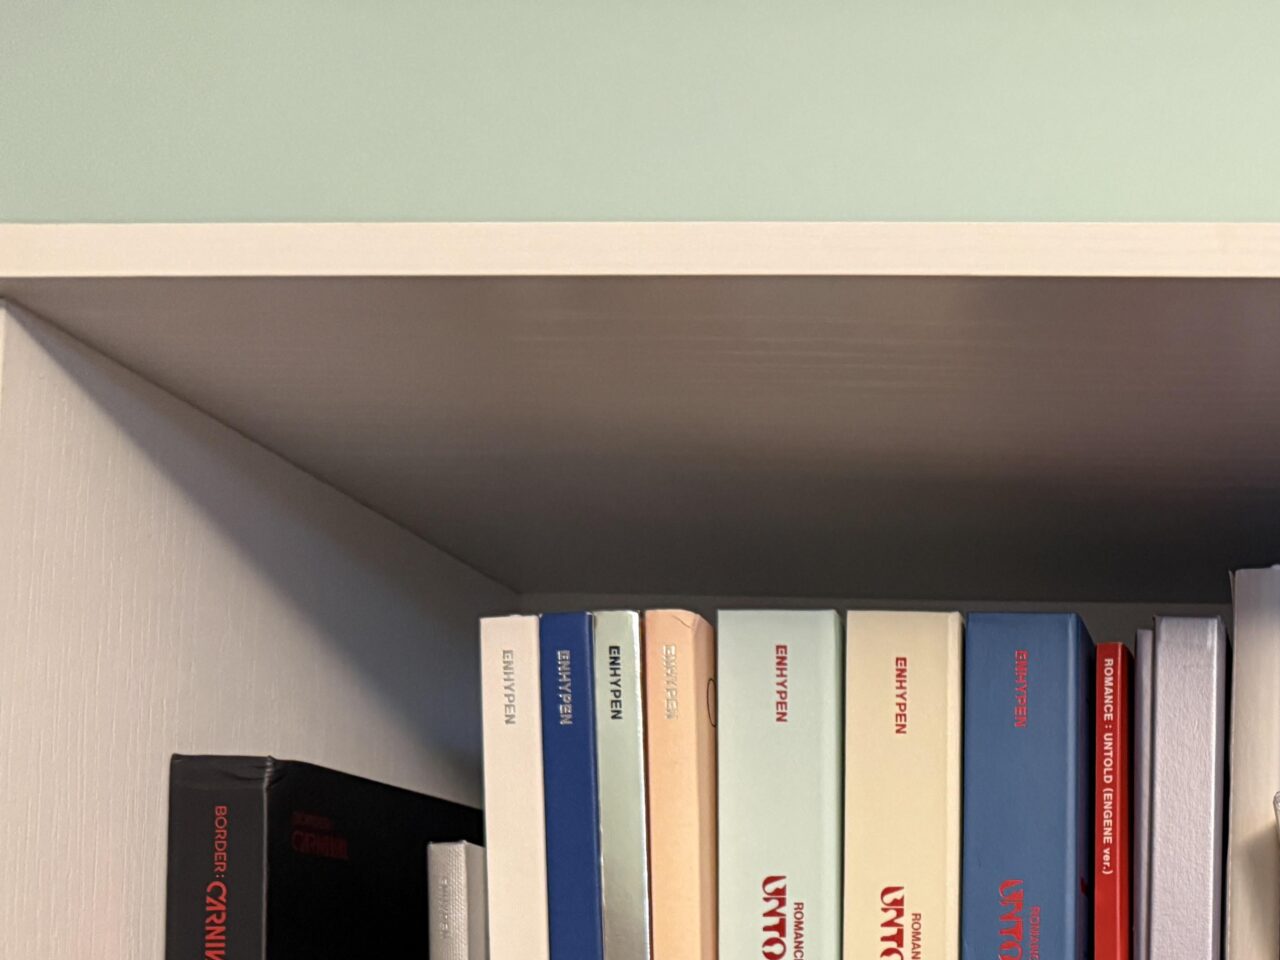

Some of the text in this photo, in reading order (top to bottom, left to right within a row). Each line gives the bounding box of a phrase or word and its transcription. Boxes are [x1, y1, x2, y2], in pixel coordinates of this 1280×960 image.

[502, 649, 516, 725] ENHYPEN
[557, 649, 573, 725] ENHYPEN
[608, 645, 623, 720] ENHYPEN
[663, 644, 679, 720] ENHYPEN
[776, 645, 788, 722] ENHYPEN
[895, 657, 907, 734] ENHYPEN
[1014, 649, 1028, 728] ENHYPEN
[1104, 658, 1114, 721] ROMANCE
[1103, 733, 1114, 783] UNTOLD
[1102, 788, 1114, 844] (ENGENE
[1102, 847, 1114, 875] ver.)
